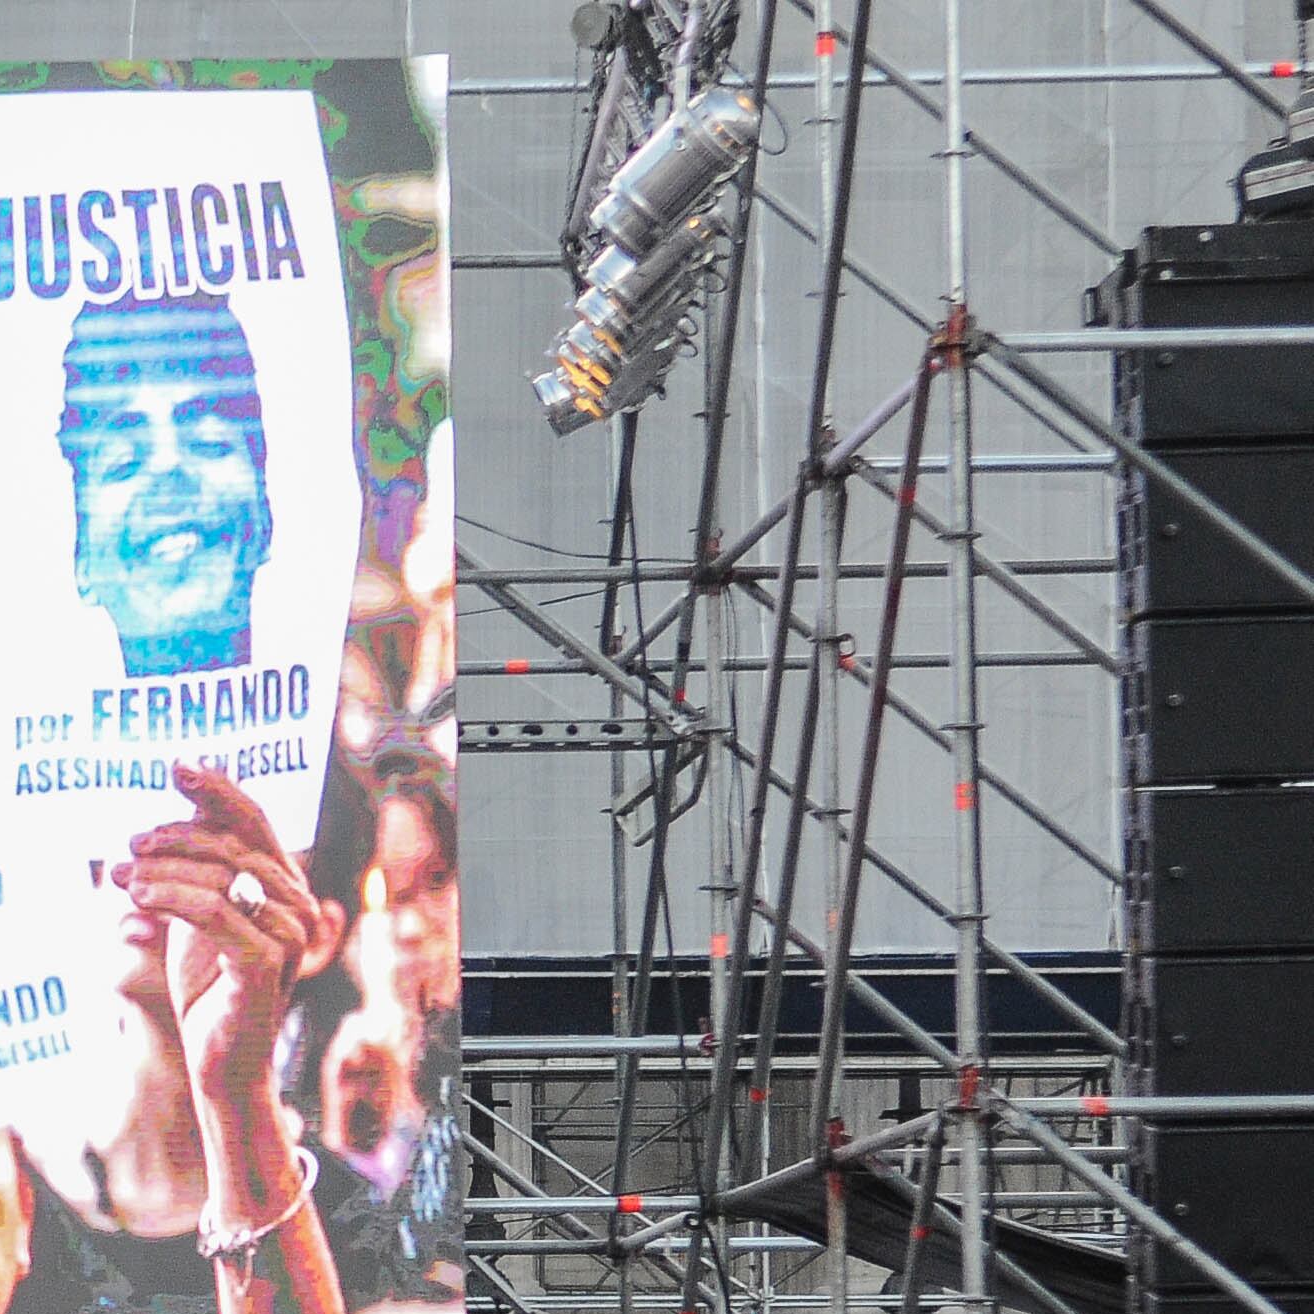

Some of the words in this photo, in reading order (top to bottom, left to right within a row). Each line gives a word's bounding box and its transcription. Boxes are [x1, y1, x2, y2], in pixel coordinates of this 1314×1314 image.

[15, 712, 74, 750] por
[92, 663, 310, 743] FERNANDO
[15, 757, 180, 797] ASESINAD
[237, 736, 309, 782] GESELL
